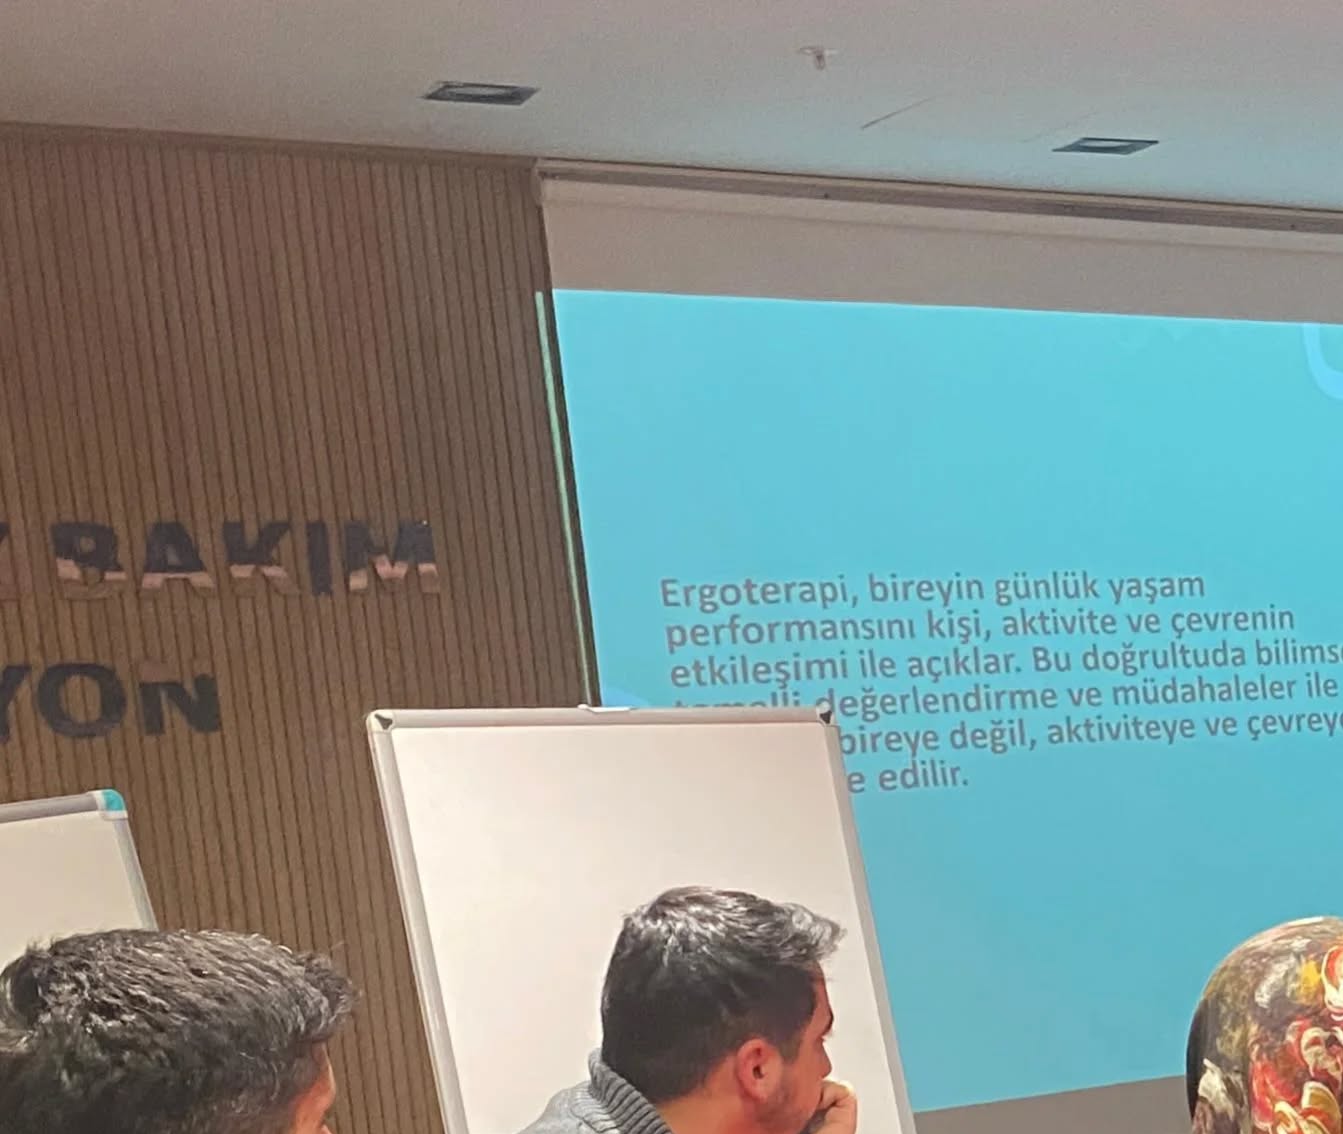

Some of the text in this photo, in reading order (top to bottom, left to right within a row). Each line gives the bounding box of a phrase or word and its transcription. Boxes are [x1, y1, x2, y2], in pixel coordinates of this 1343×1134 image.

[50, 519, 440, 598] BAKIM
[660, 571, 1206, 614] Ergoterapi, bireyin günlük yaşam
[665, 604, 1295, 653] performansını kişi, aktivite ve çevrenin
[670, 650, 848, 690] etkileşimi
[858, 649, 897, 679] ile
[906, 646, 1022, 683] açıklar.
[1031, 646, 1072, 673] Bu
[1081, 641, 1247, 677] doğrultuda
[1066, 688, 1103, 709] ve
[1112, 673, 1297, 707] müdahaleler
[1305, 672, 1339, 700] ile
[949, 719, 1038, 754] değil,
[1046, 714, 1196, 746] aktiviteye
[1204, 717, 1238, 738] ve
[878, 759, 969, 792] edilir.
